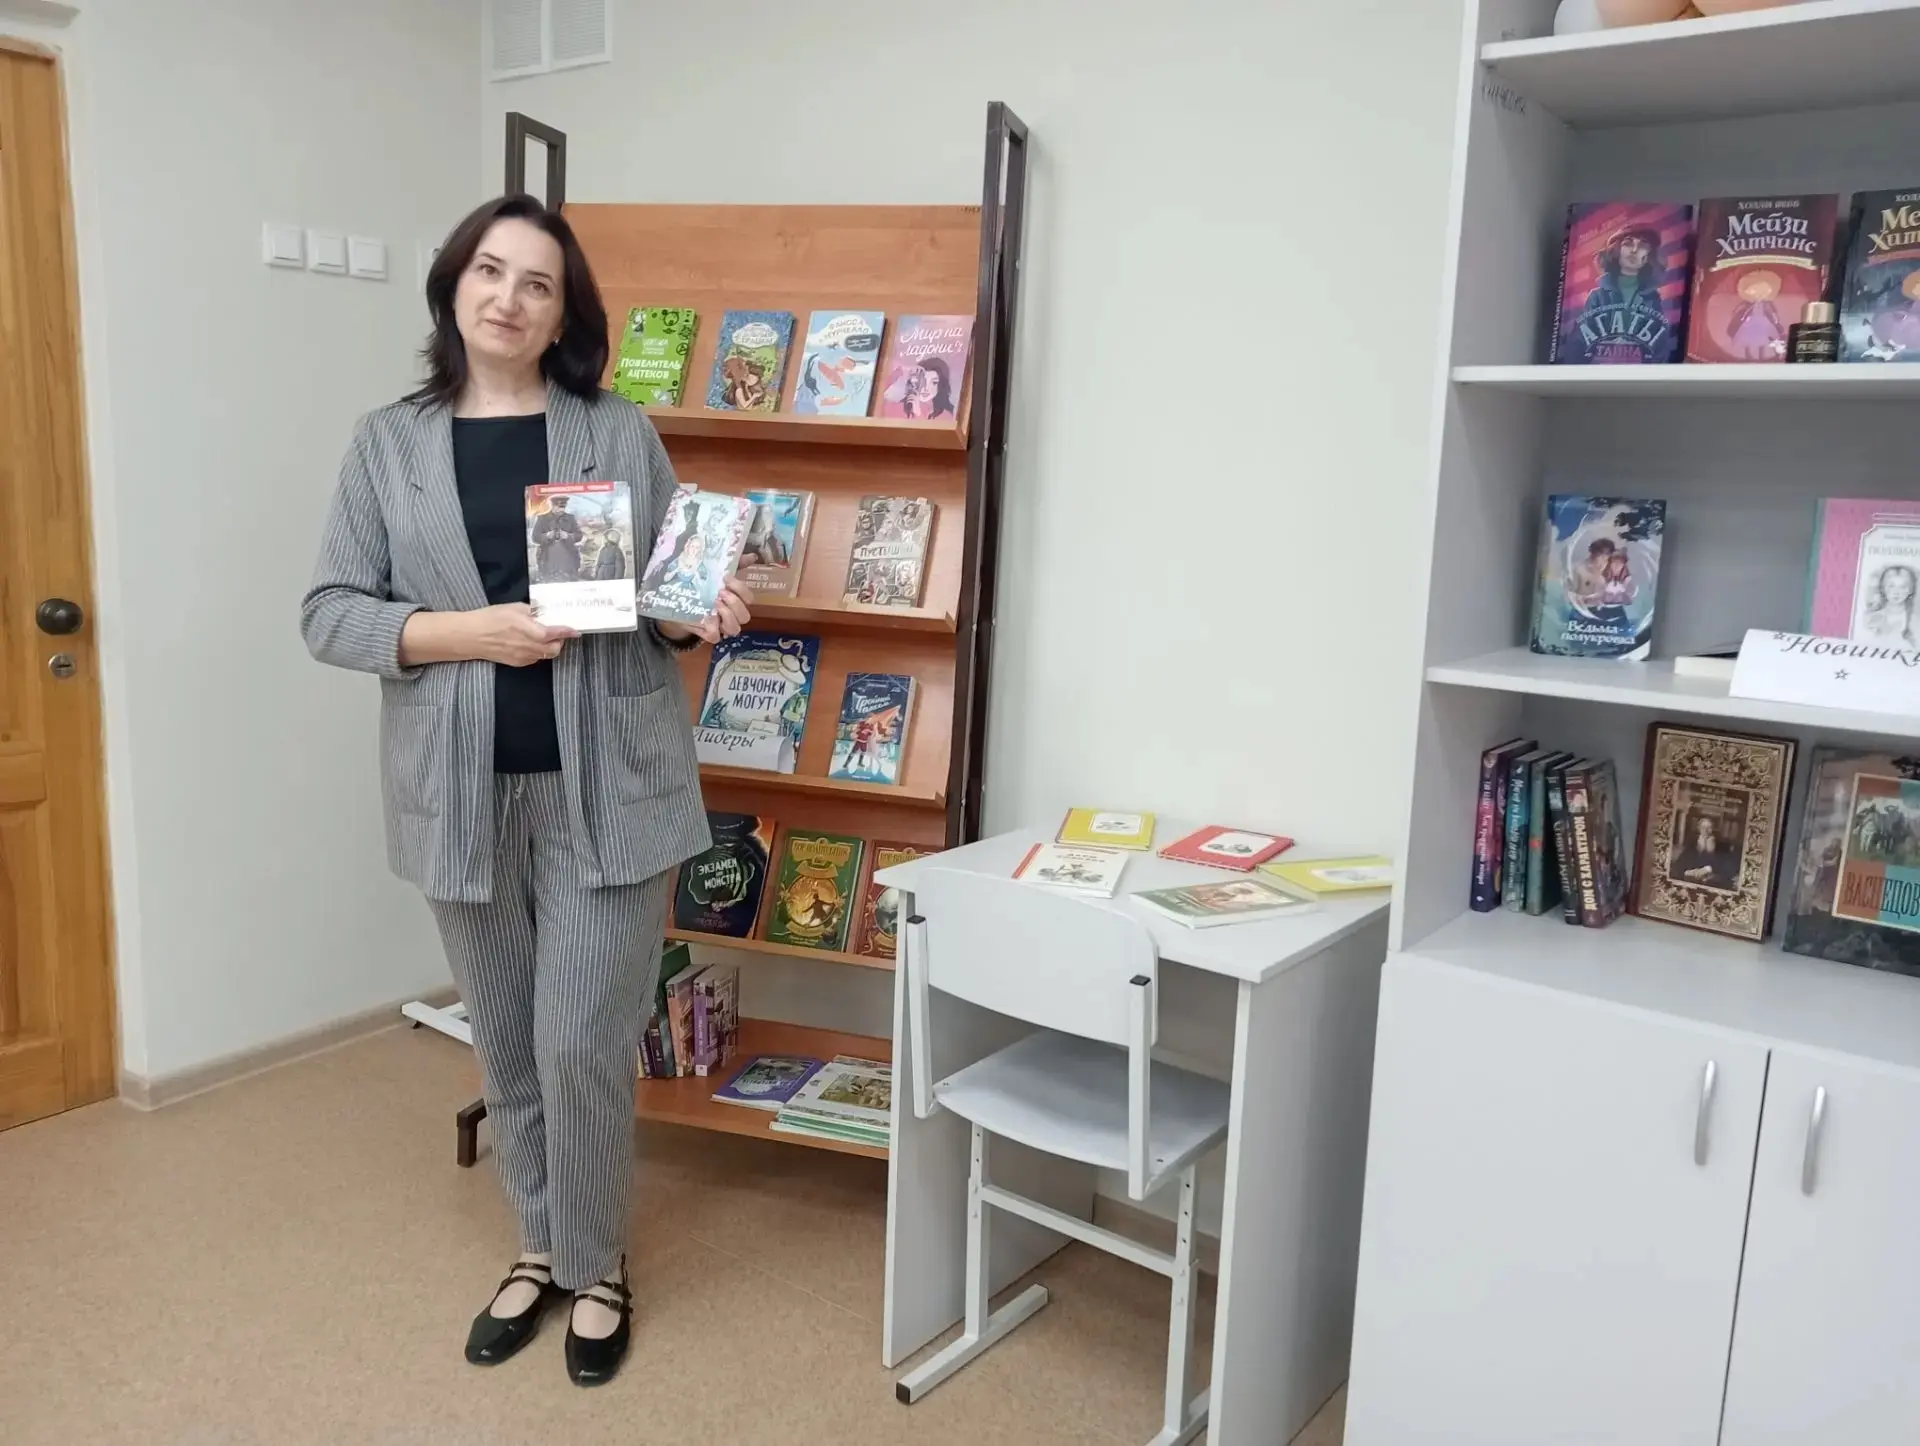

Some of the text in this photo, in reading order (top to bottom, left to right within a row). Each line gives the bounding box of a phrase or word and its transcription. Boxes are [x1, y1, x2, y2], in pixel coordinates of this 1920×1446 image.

[1727, 212, 1809, 238] Мейзи
[1716, 235, 1817, 257] Хитчинс
[1580, 311, 1666, 346] АГАТЫ
[728, 675, 787, 695] ДЕВЧОНКИ
[1574, 816, 1594, 879] ХАРАКТЕРОМ
[1583, 889, 1598, 911] ДОМ
[1841, 871, 1920, 920] ВАСНЕЦОВ
